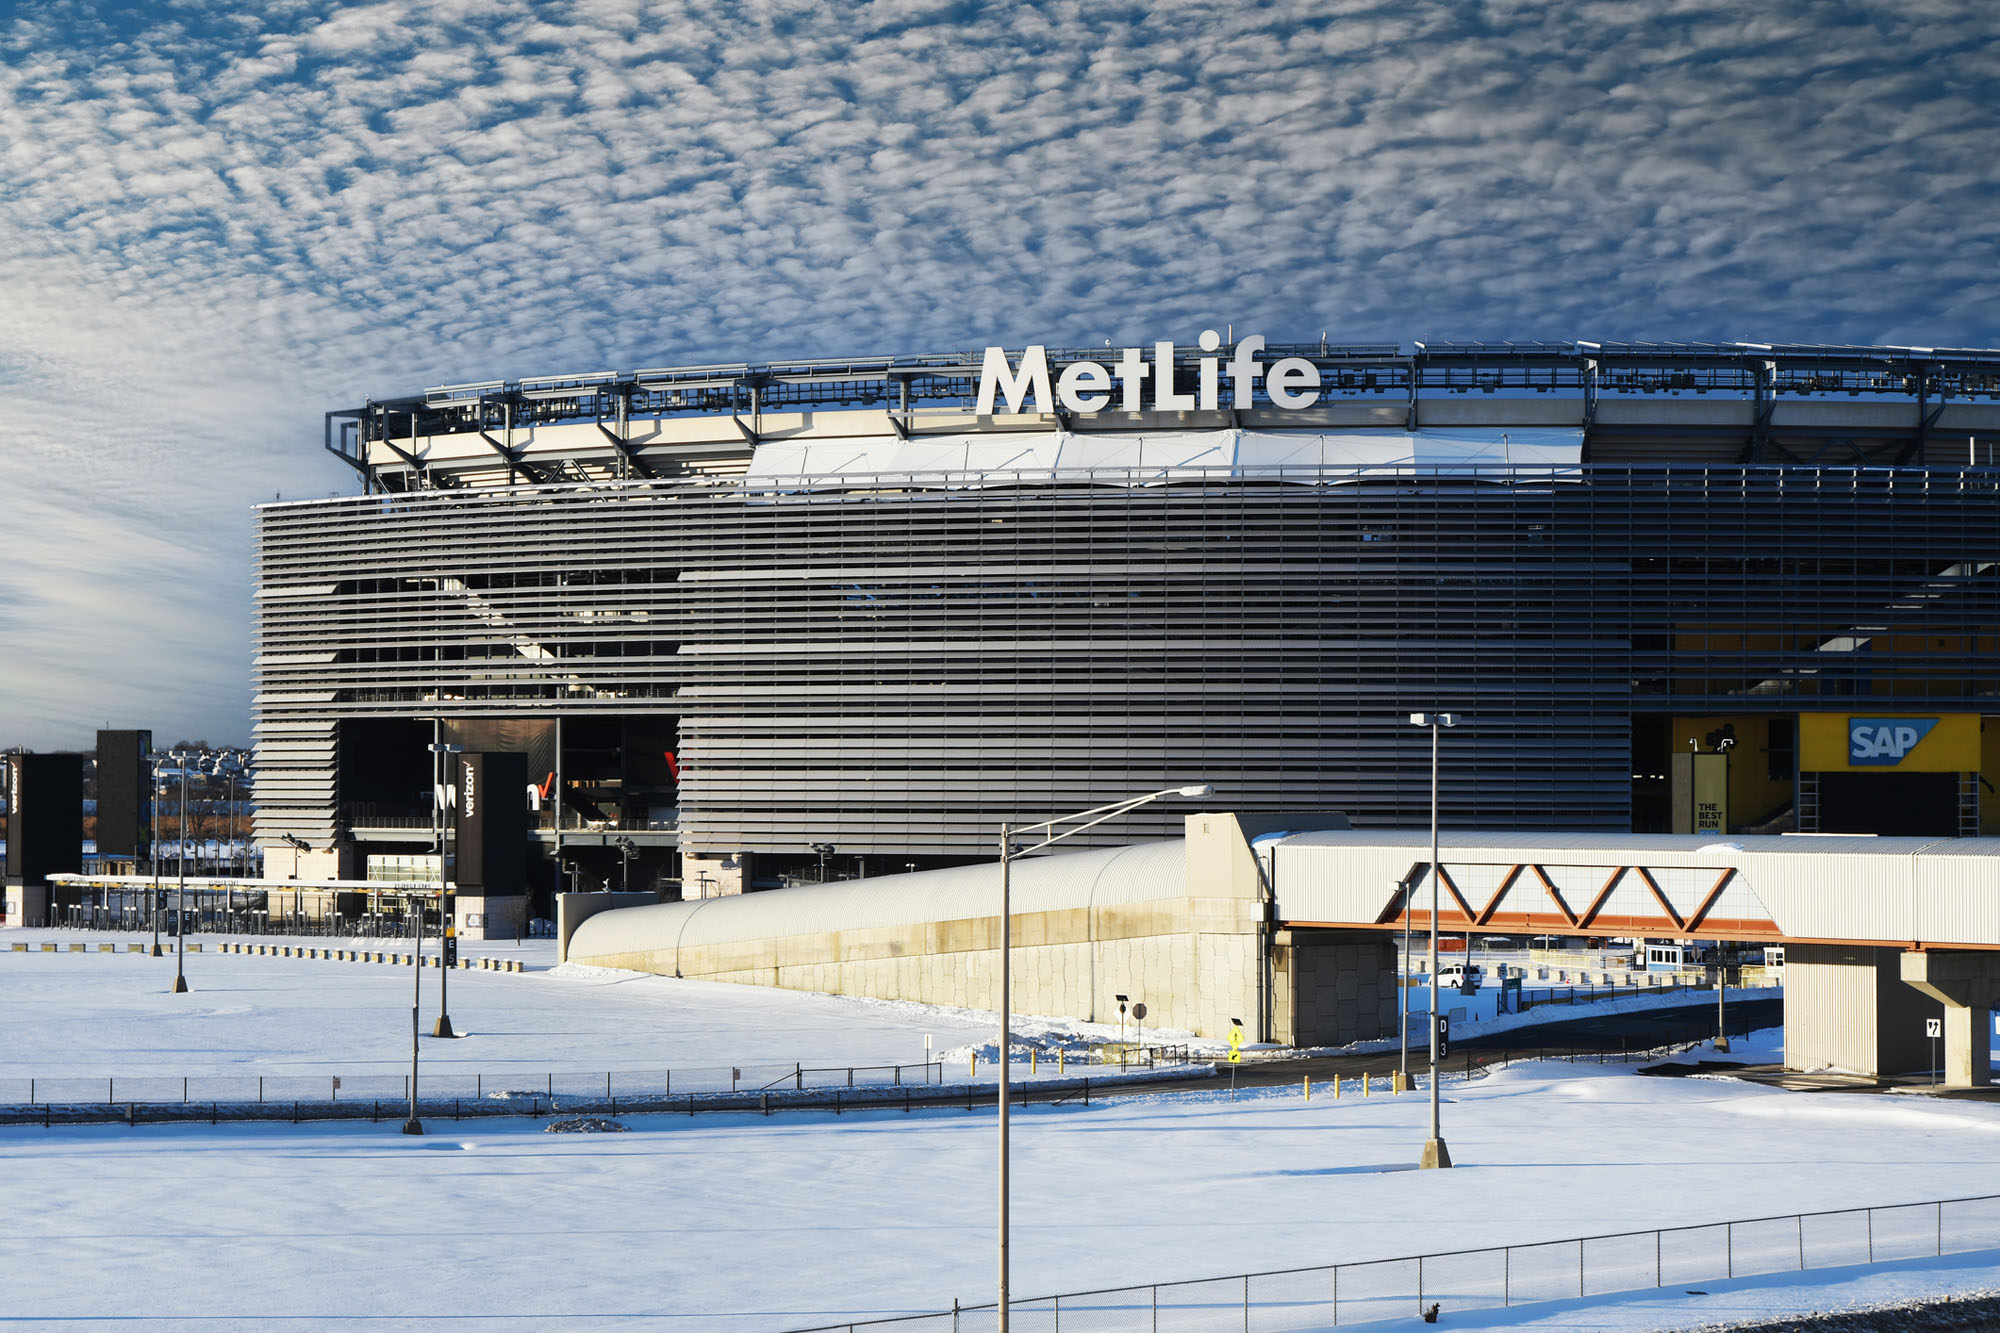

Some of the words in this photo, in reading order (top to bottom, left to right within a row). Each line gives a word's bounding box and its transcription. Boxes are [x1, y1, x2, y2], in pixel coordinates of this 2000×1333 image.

[975, 329, 1321, 416] MetLife
[1851, 726, 1918, 758] SAP
[463, 766, 475, 818] verizon
[1698, 803, 1718, 811] THE
[1698, 811, 1723, 820] BEST
[1698, 820, 1719, 828] RUN
[185, 912, 191, 921] E
[448, 939, 455, 949] E
[1440, 1019, 1447, 1033] D
[1440, 1042, 1447, 1056] 3
